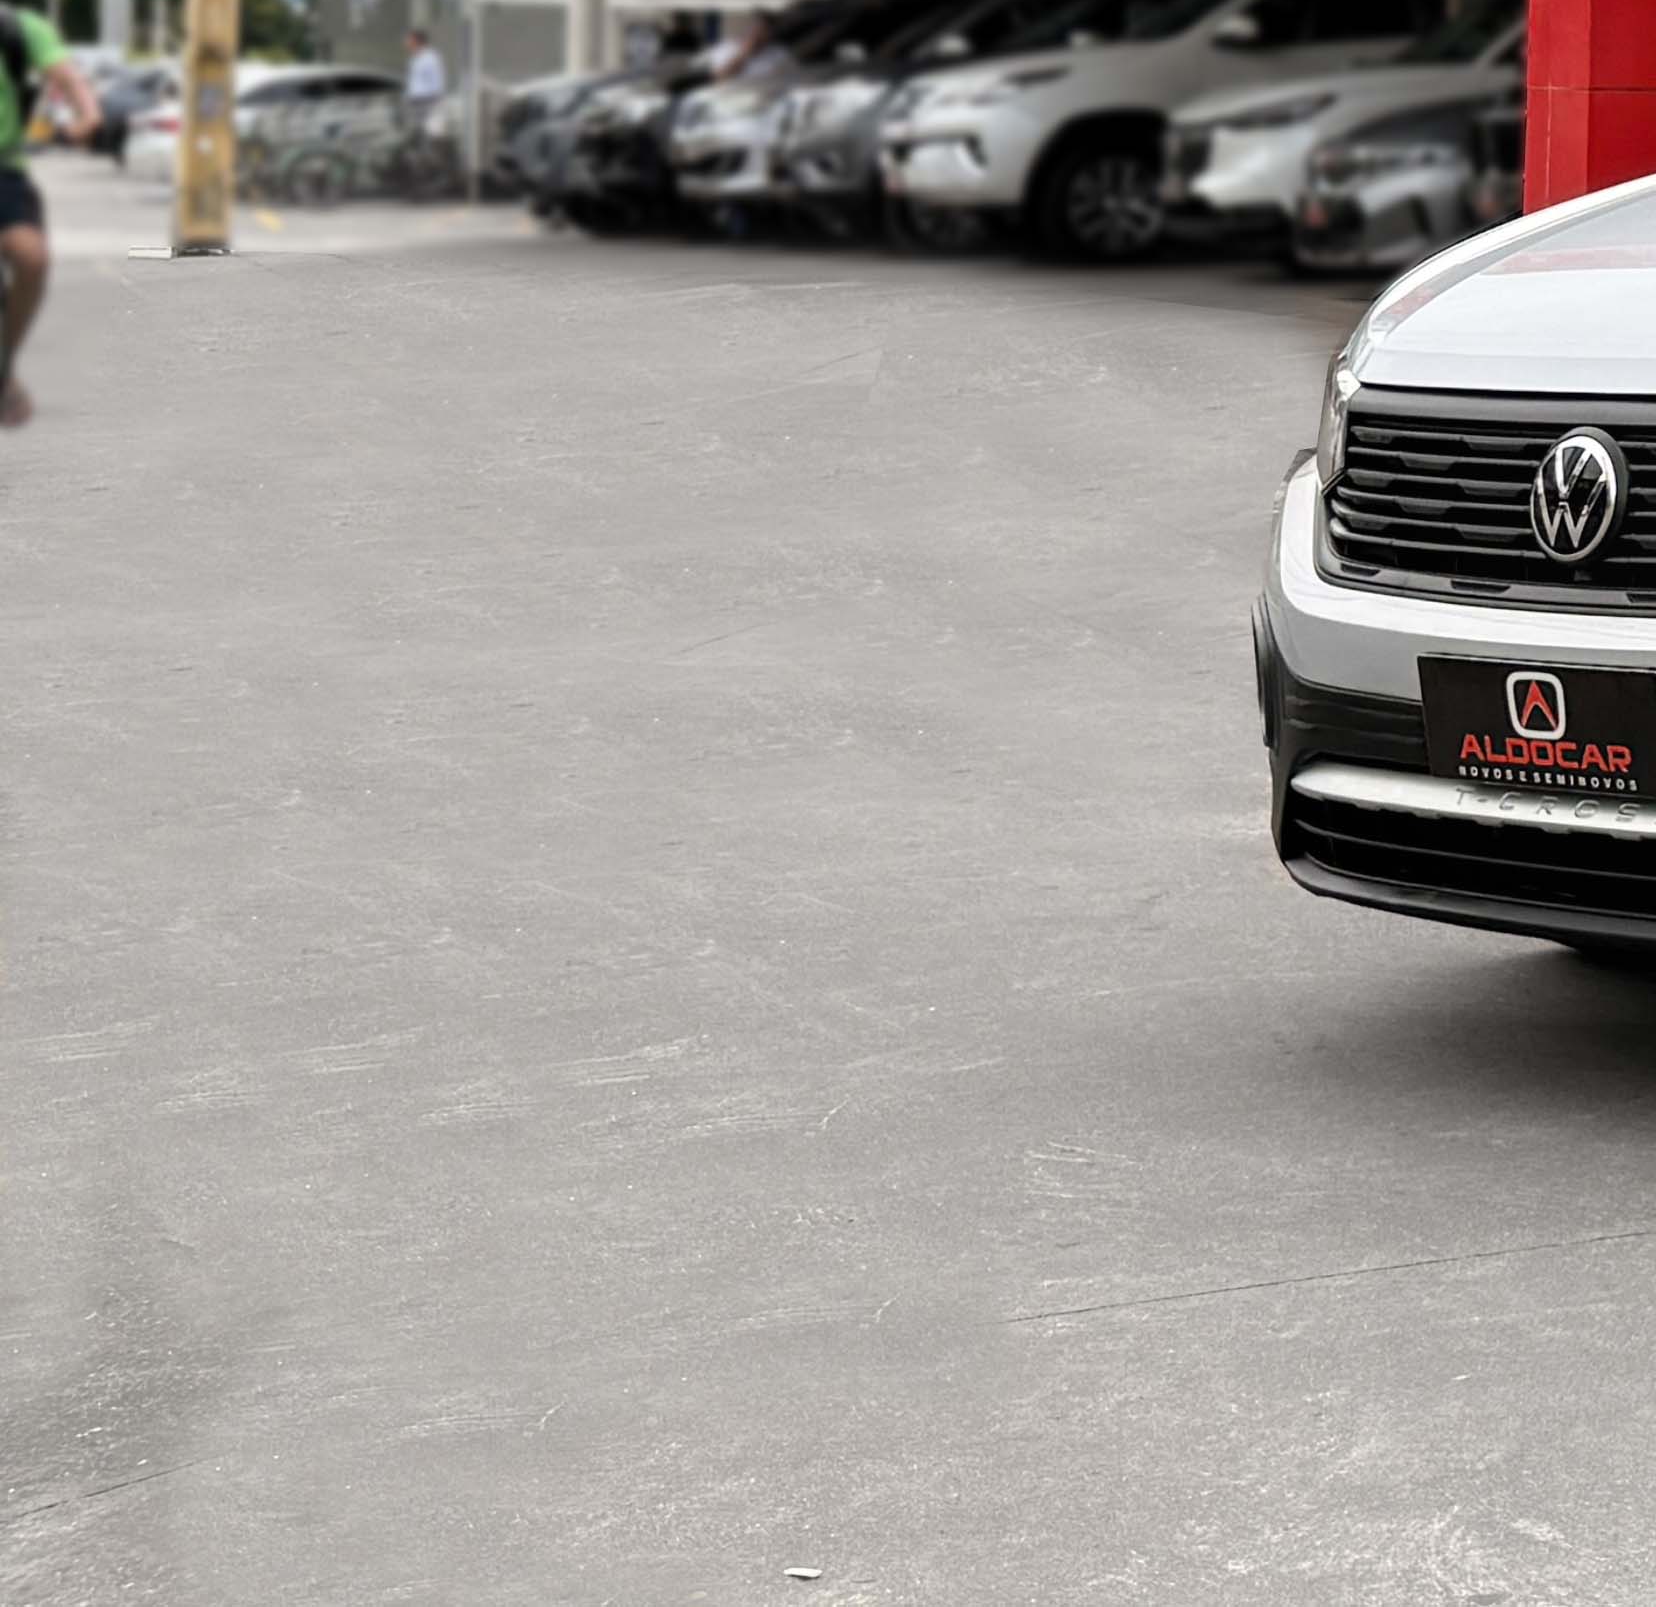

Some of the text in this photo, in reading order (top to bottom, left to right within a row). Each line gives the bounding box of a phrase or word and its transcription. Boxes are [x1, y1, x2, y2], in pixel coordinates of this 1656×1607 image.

[1459, 733, 1633, 773] ALDOCAR
[1458, 765, 1513, 781] NOVOS
[1533, 772, 1639, 791] SEMINOVOS
